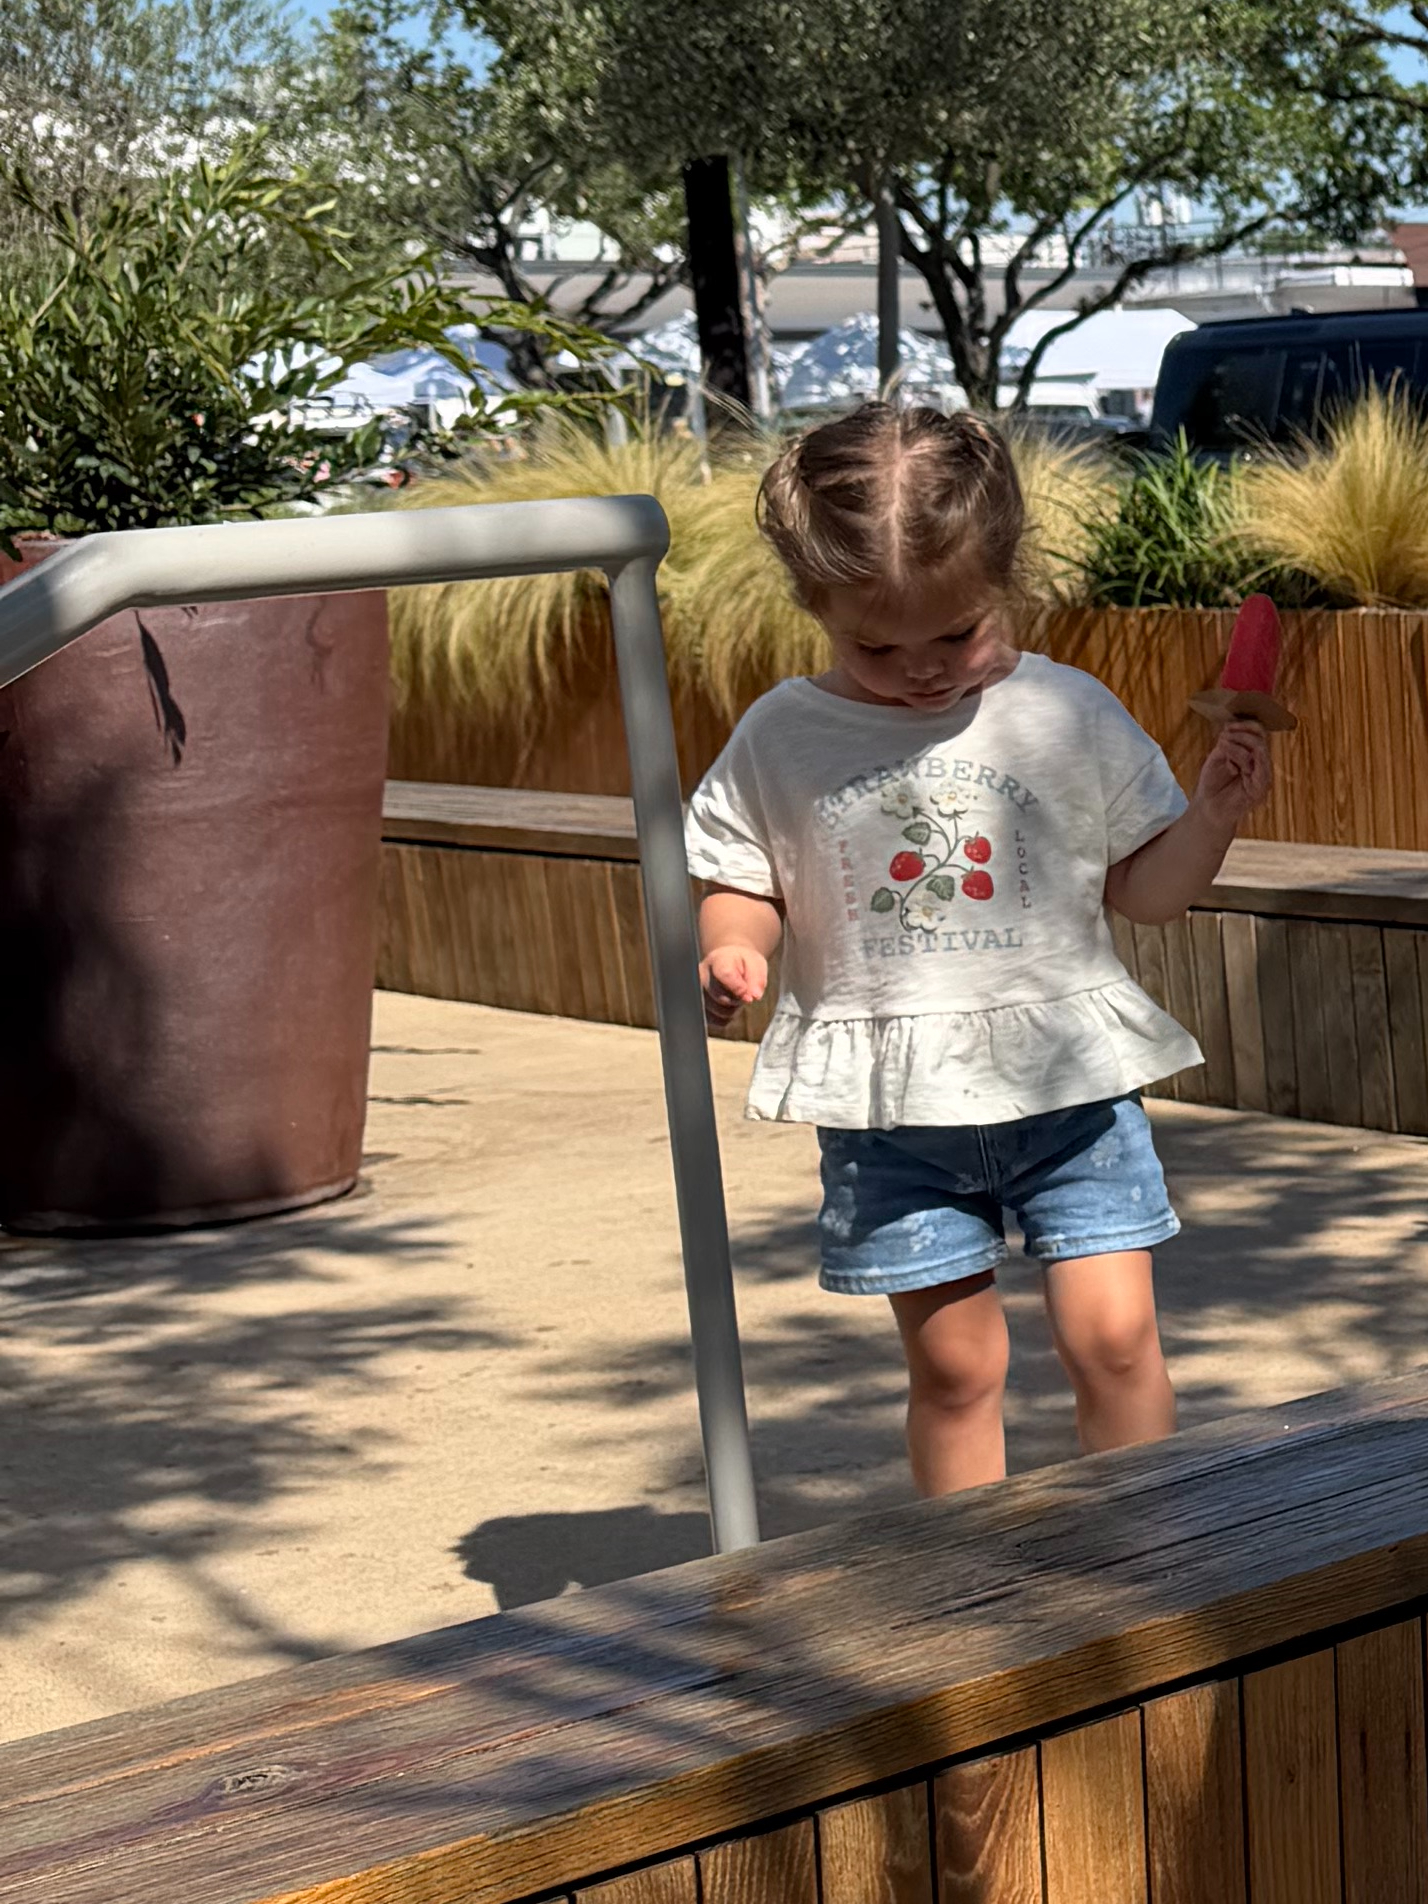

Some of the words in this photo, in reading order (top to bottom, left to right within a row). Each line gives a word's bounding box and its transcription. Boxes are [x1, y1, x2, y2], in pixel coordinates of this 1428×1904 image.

[815, 756, 1039, 829] STRAWBERRY
[838, 839, 859, 922] FRESH
[1014, 829, 1032, 909] LOCAL
[862, 927, 1024, 959] FESTIVAL
